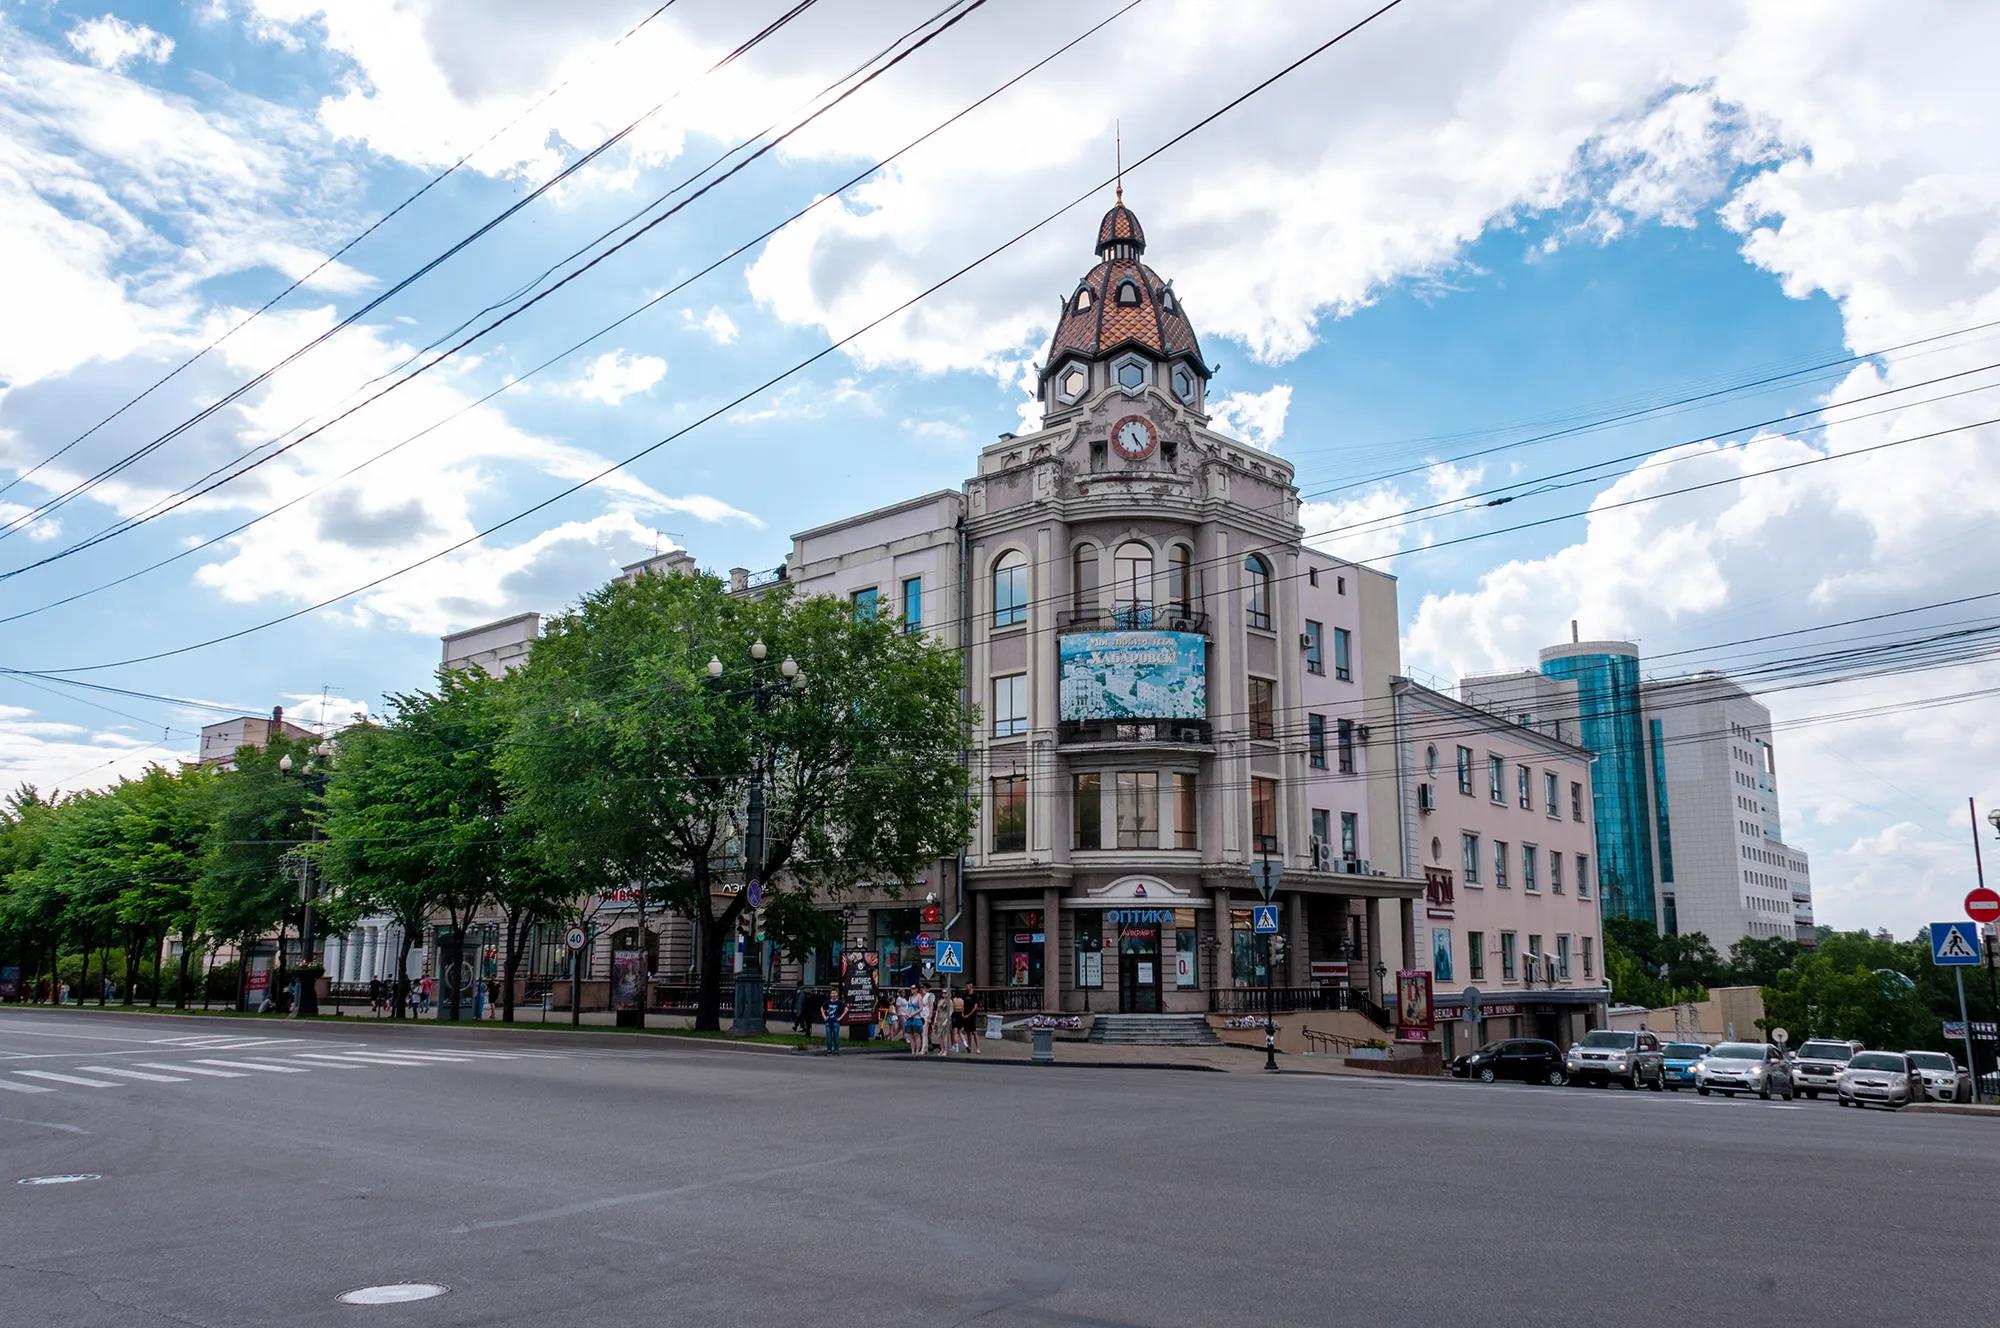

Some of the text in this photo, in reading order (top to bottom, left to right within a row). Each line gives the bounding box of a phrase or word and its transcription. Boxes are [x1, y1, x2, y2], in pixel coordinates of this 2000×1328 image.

[1107, 910, 1174, 924] ОПТИКА
[570, 934, 581, 943] 40
[1434, 1008, 1454, 1018] ДЕЖДА
